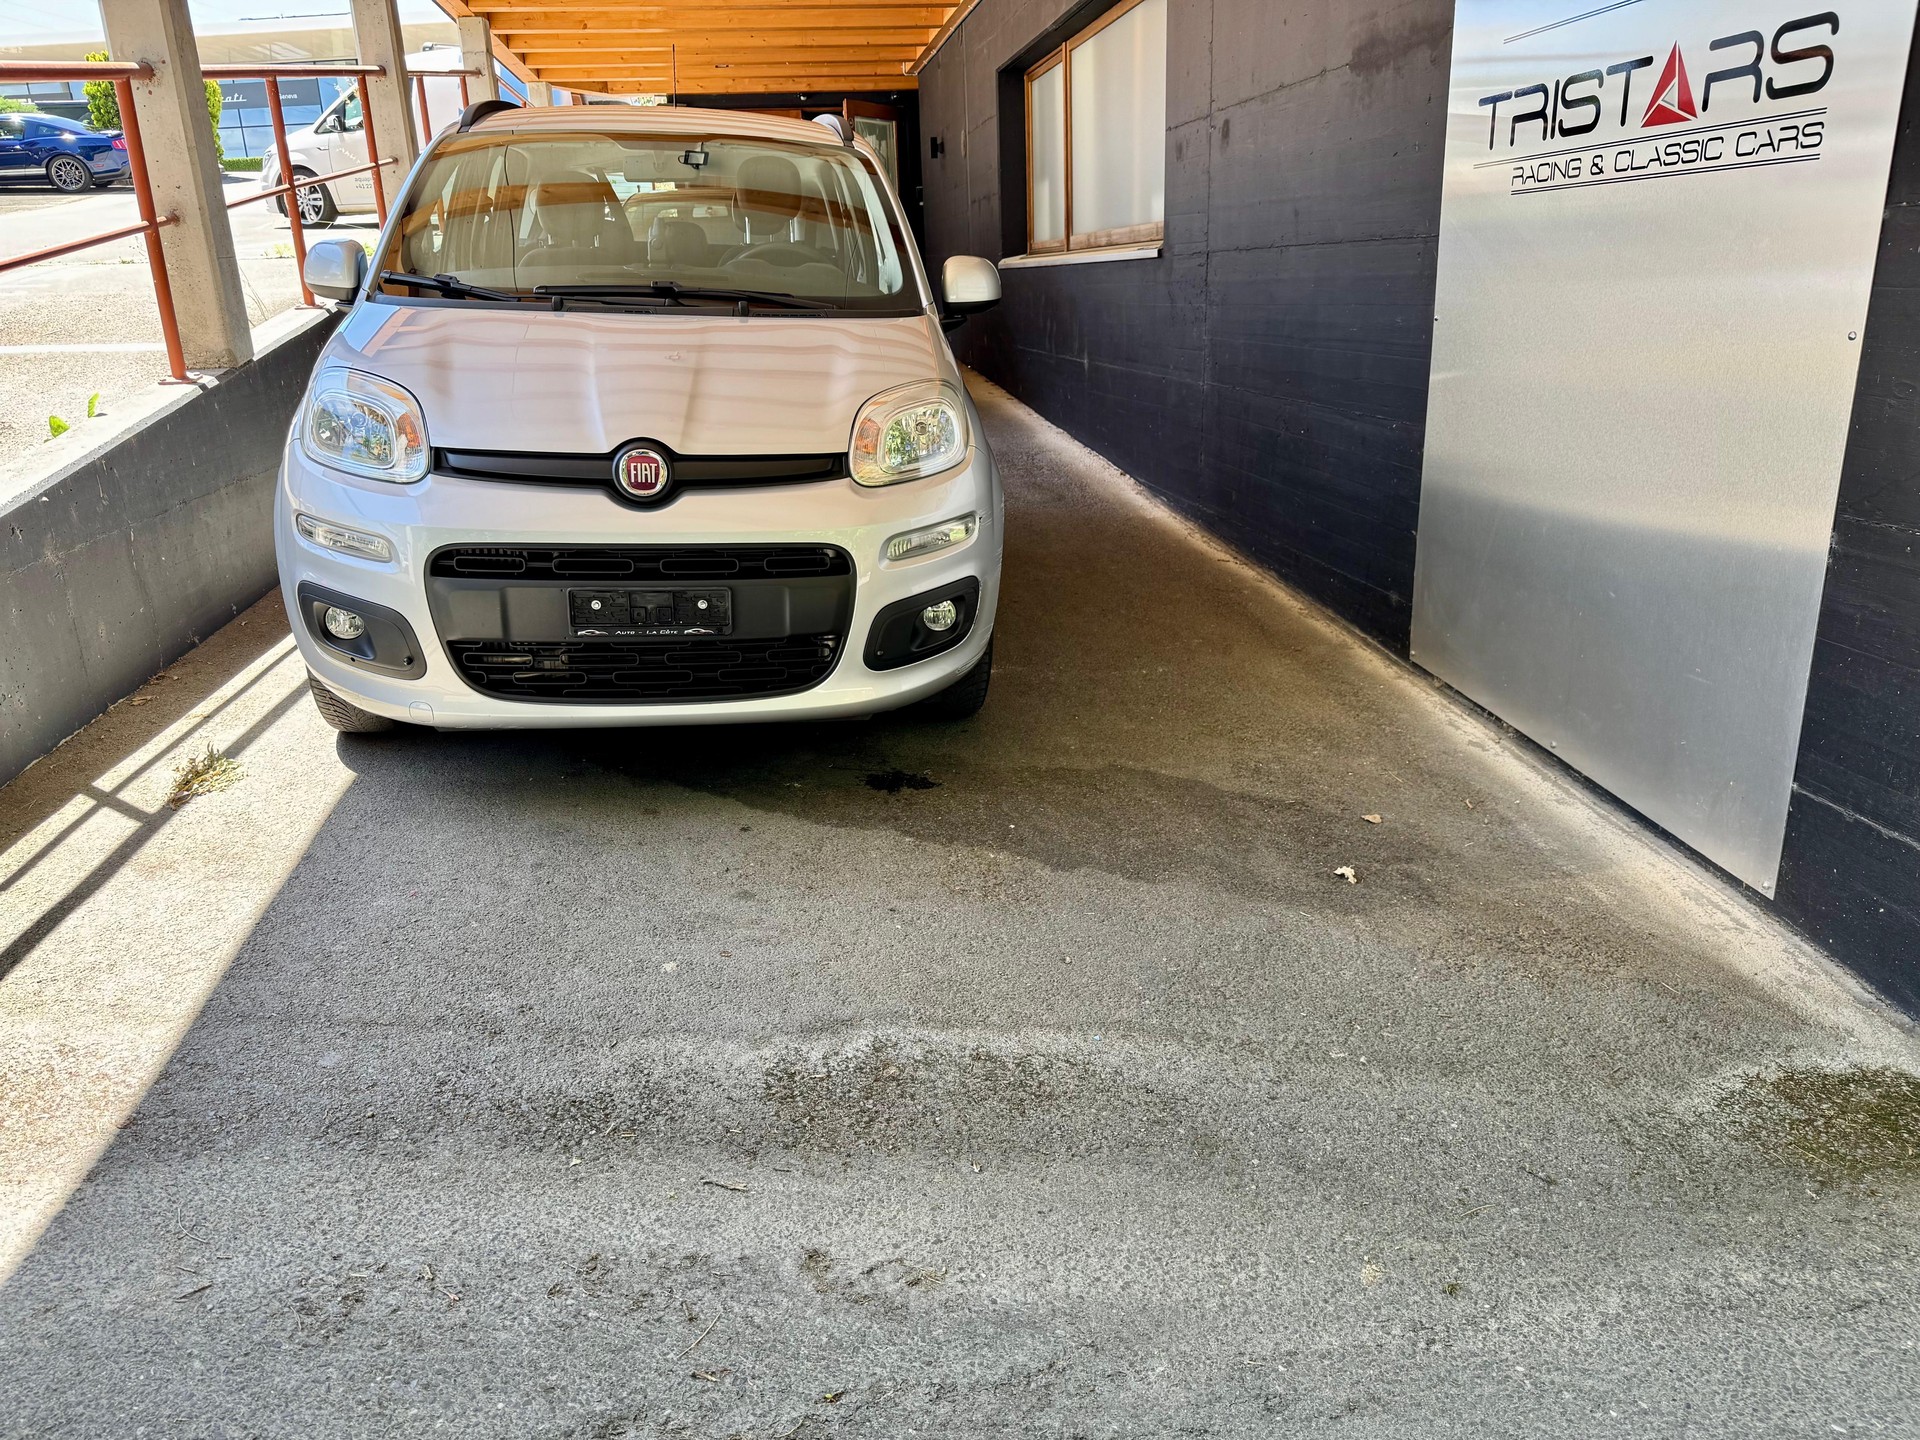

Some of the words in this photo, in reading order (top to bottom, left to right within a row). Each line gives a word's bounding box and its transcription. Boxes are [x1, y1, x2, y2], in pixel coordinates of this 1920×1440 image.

[1478, 11, 1839, 151] TRISTARS
[1511, 157, 1582, 187] RACING
[1590, 154, 1605, 176] &
[1614, 136, 1724, 173] CLASSIC
[1735, 121, 1825, 158] CARS
[630, 462, 657, 483] FIAT
